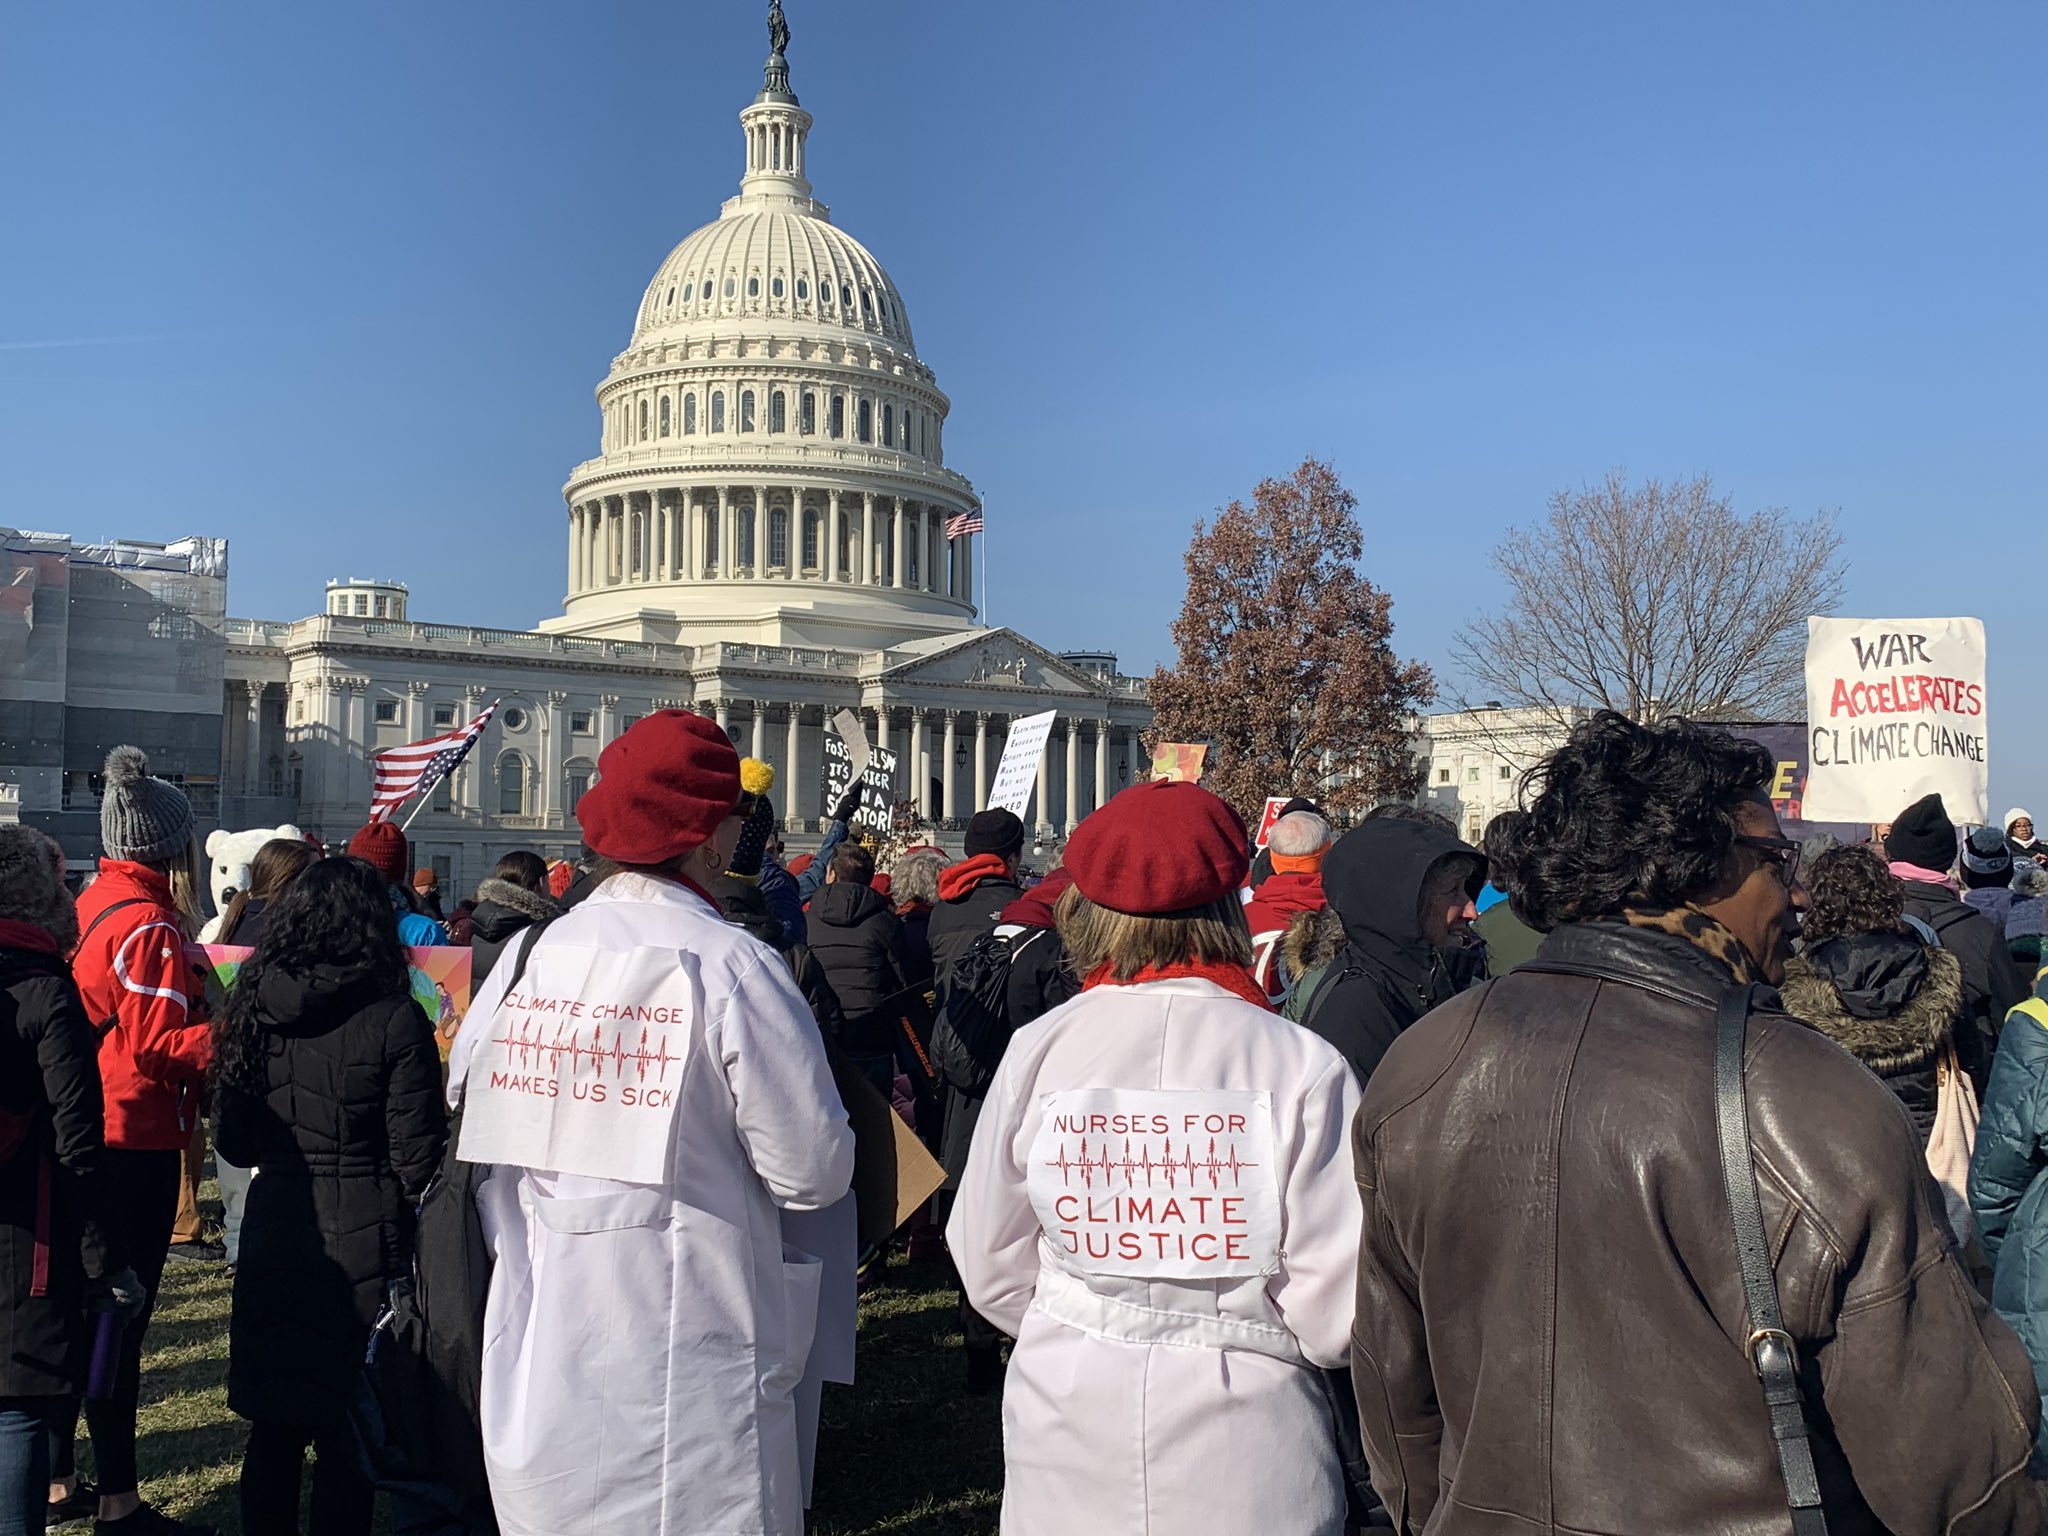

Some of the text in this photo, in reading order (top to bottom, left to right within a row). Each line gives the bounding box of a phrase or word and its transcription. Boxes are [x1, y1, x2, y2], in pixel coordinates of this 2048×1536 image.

[1850, 633, 1933, 672] WAR
[1829, 674, 1982, 718] ACCELERATES
[825, 738, 853, 761] FOSS
[1913, 721, 1985, 763] CHANGE
[829, 761, 890, 791] IT'S SIER
[999, 778, 1013, 788] BUT
[828, 779, 842, 794] TO
[873, 792, 885, 809] A
[503, 992, 684, 1024] CLIMATE CHANGE
[490, 1071, 673, 1108] MAKES US SICK
[1053, 1114, 1246, 1134] NURSES FOR
[1055, 1195, 1247, 1224] CLIMATE
[1060, 1229, 1250, 1261] JUSTICE
